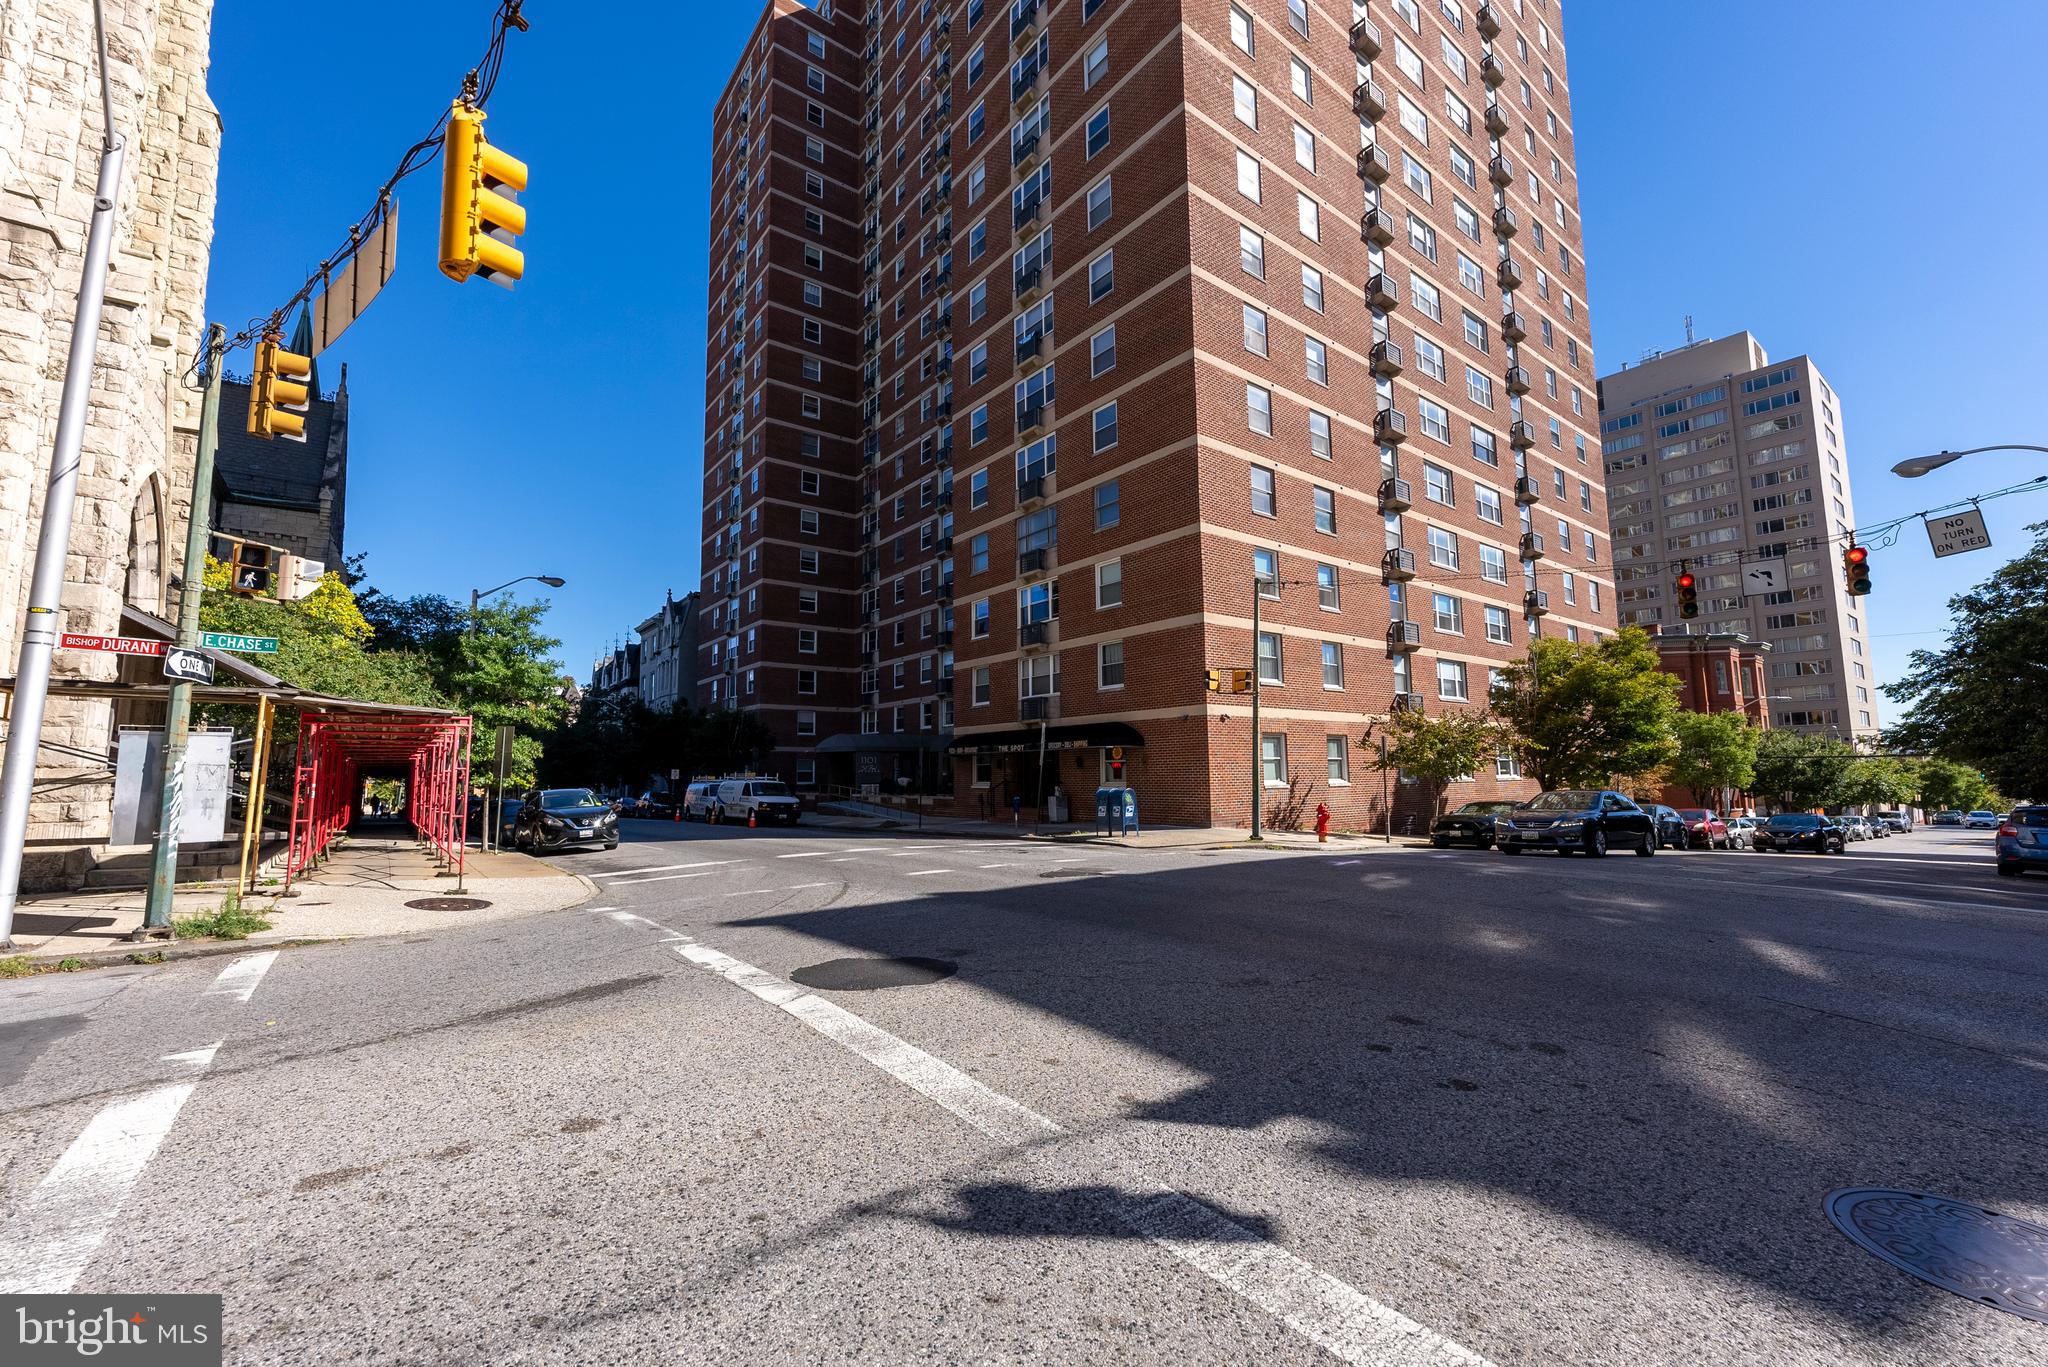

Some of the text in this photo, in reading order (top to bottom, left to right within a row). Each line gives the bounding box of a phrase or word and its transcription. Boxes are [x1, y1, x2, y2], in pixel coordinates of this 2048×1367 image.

[1945, 518, 1963, 529] NO
[1943, 527, 1974, 540] TURN
[1937, 535, 1985, 552] ON RED
[66, 636, 100, 647] BISHOP
[102, 638, 158, 654] DURANT
[180, 658, 199, 672] ONE
[1010, 744, 1024, 752] SPOT
